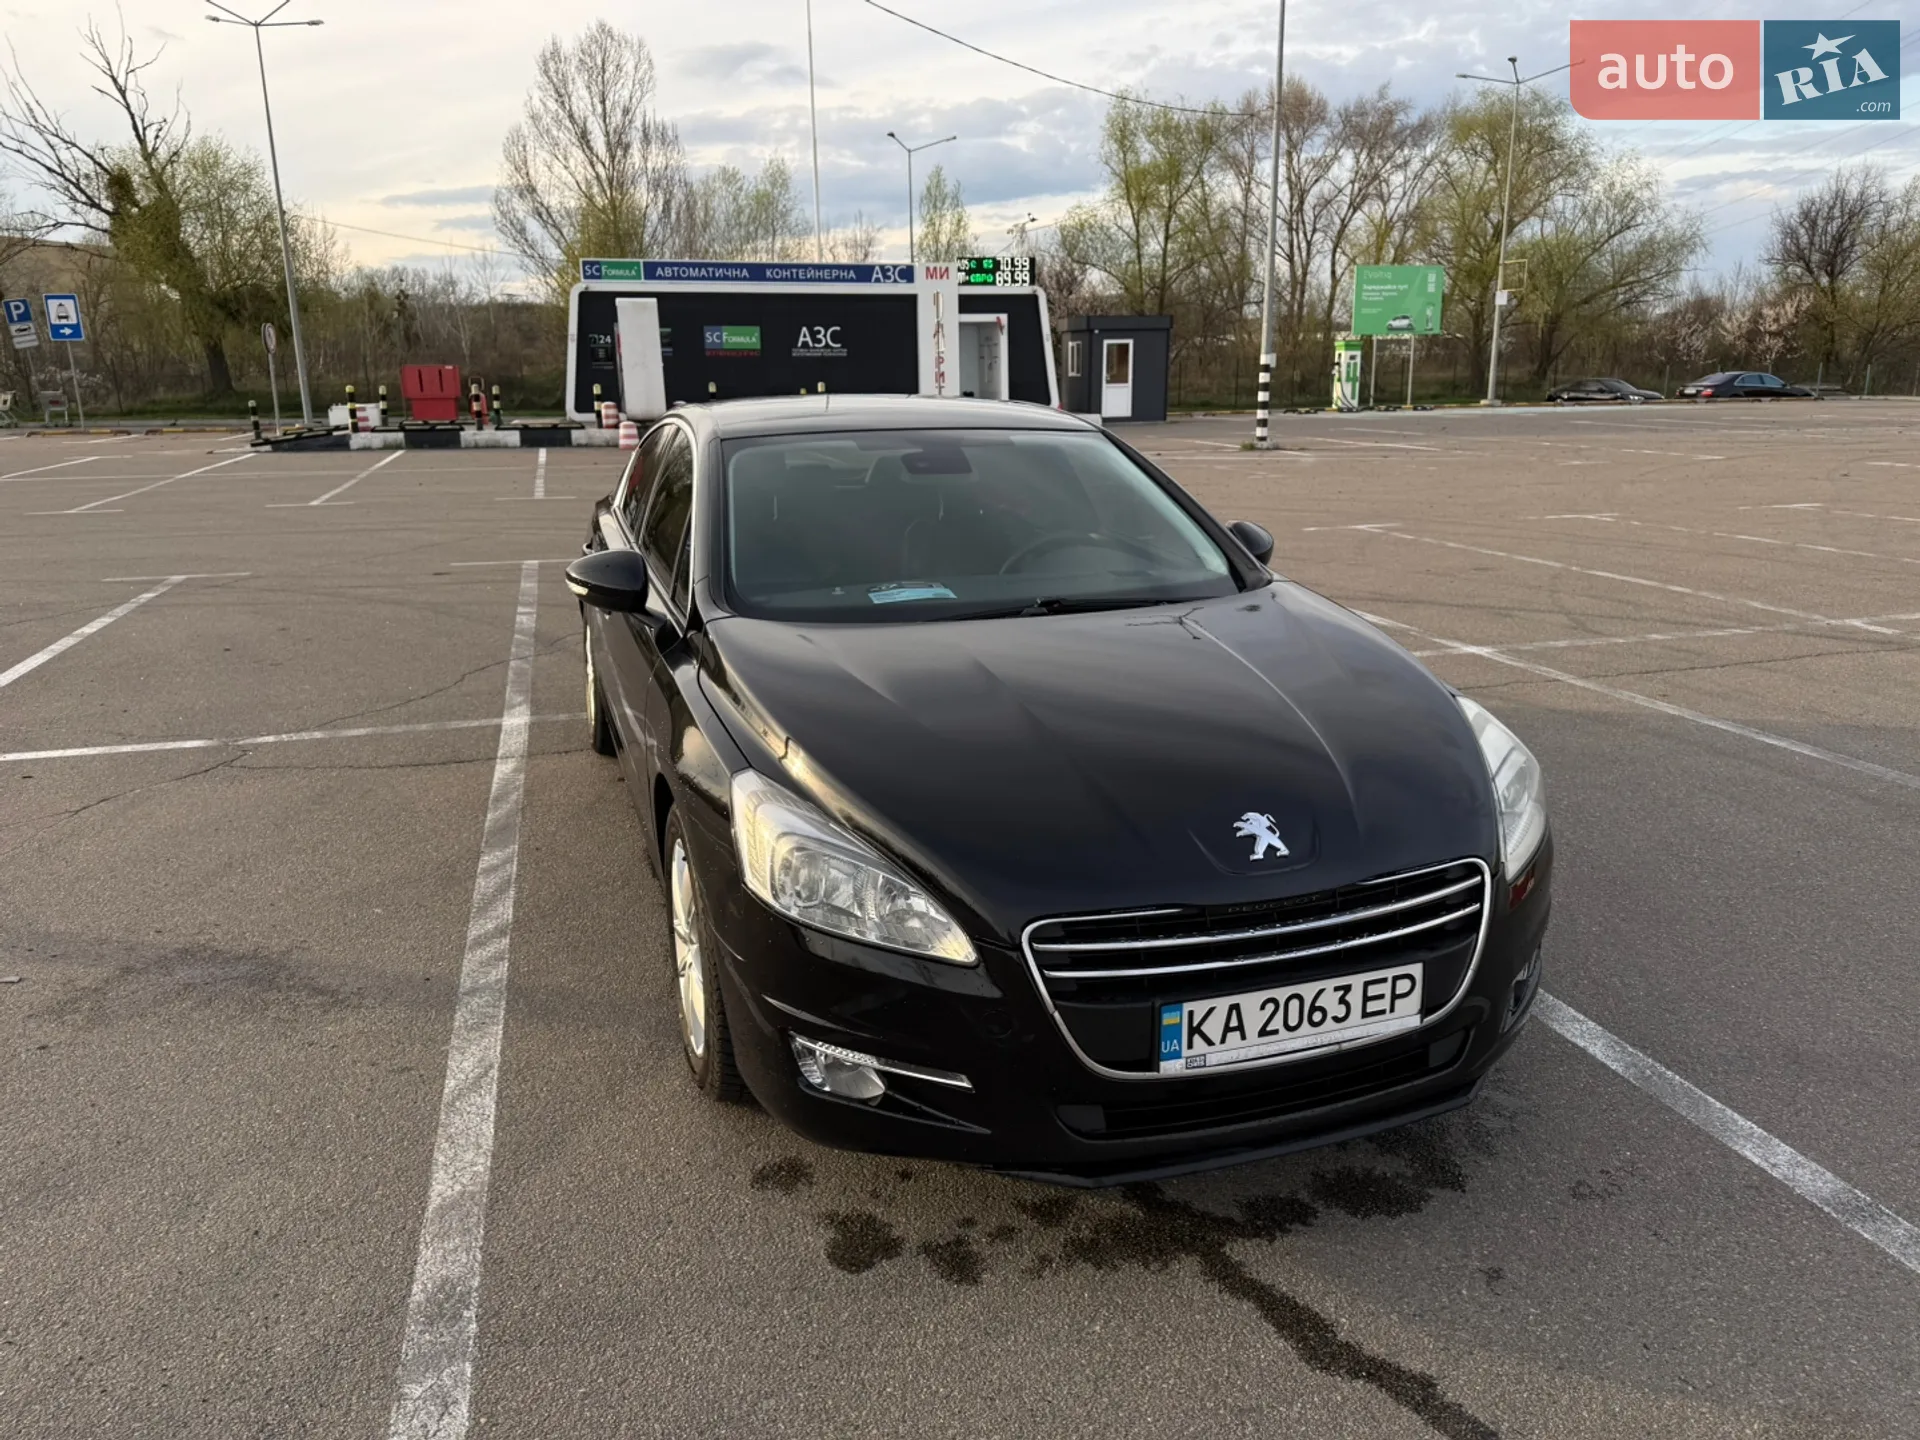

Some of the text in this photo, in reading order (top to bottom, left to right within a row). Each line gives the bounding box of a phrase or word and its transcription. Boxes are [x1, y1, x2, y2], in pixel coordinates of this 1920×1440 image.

[585, 264, 600, 276] SC
[656, 265, 908, 283] АВТОМАТИЧНА КОНТЕЙНЕРНА АЗС
[9, 301, 26, 321] P
[797, 326, 842, 347] АЗС
[1187, 1002, 1247, 1050] KA
[1257, 983, 1353, 1038] 2063
[1361, 972, 1417, 1020] EP
[1161, 1041, 1180, 1053] UA
